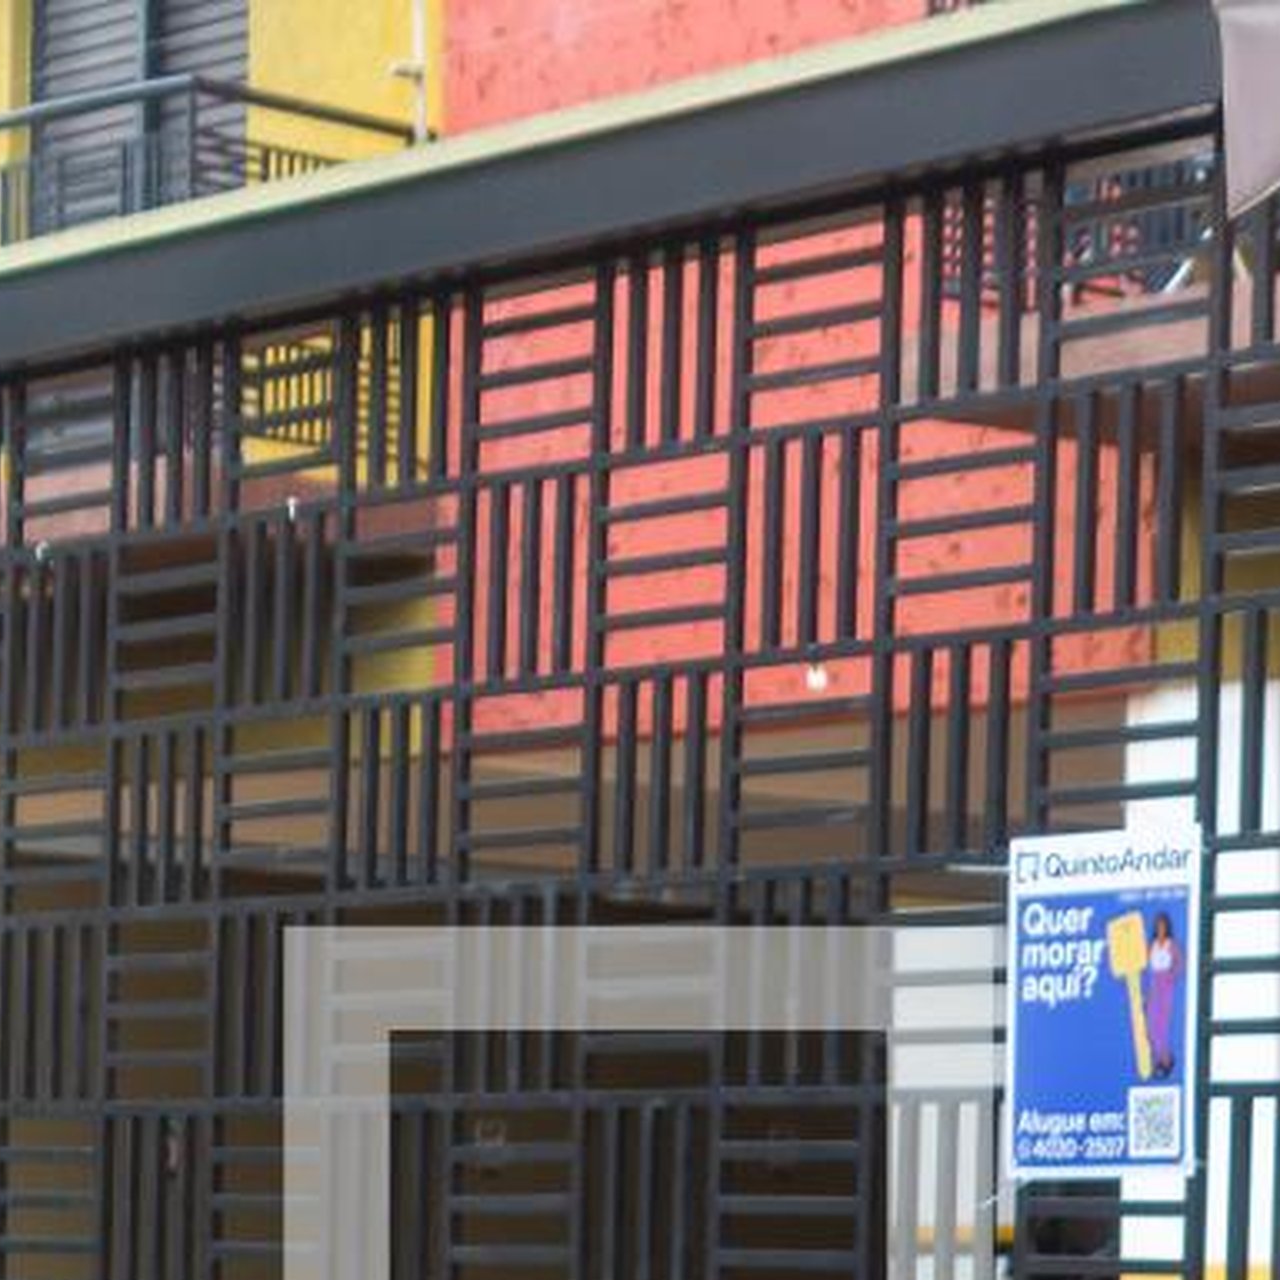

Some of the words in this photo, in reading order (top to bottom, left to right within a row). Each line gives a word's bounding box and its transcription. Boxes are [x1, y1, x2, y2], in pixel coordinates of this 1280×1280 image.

[1045, 848, 1192, 877] QuintoAndar
[1022, 902, 1093, 936] Quer
[1022, 939, 1105, 969] morar
